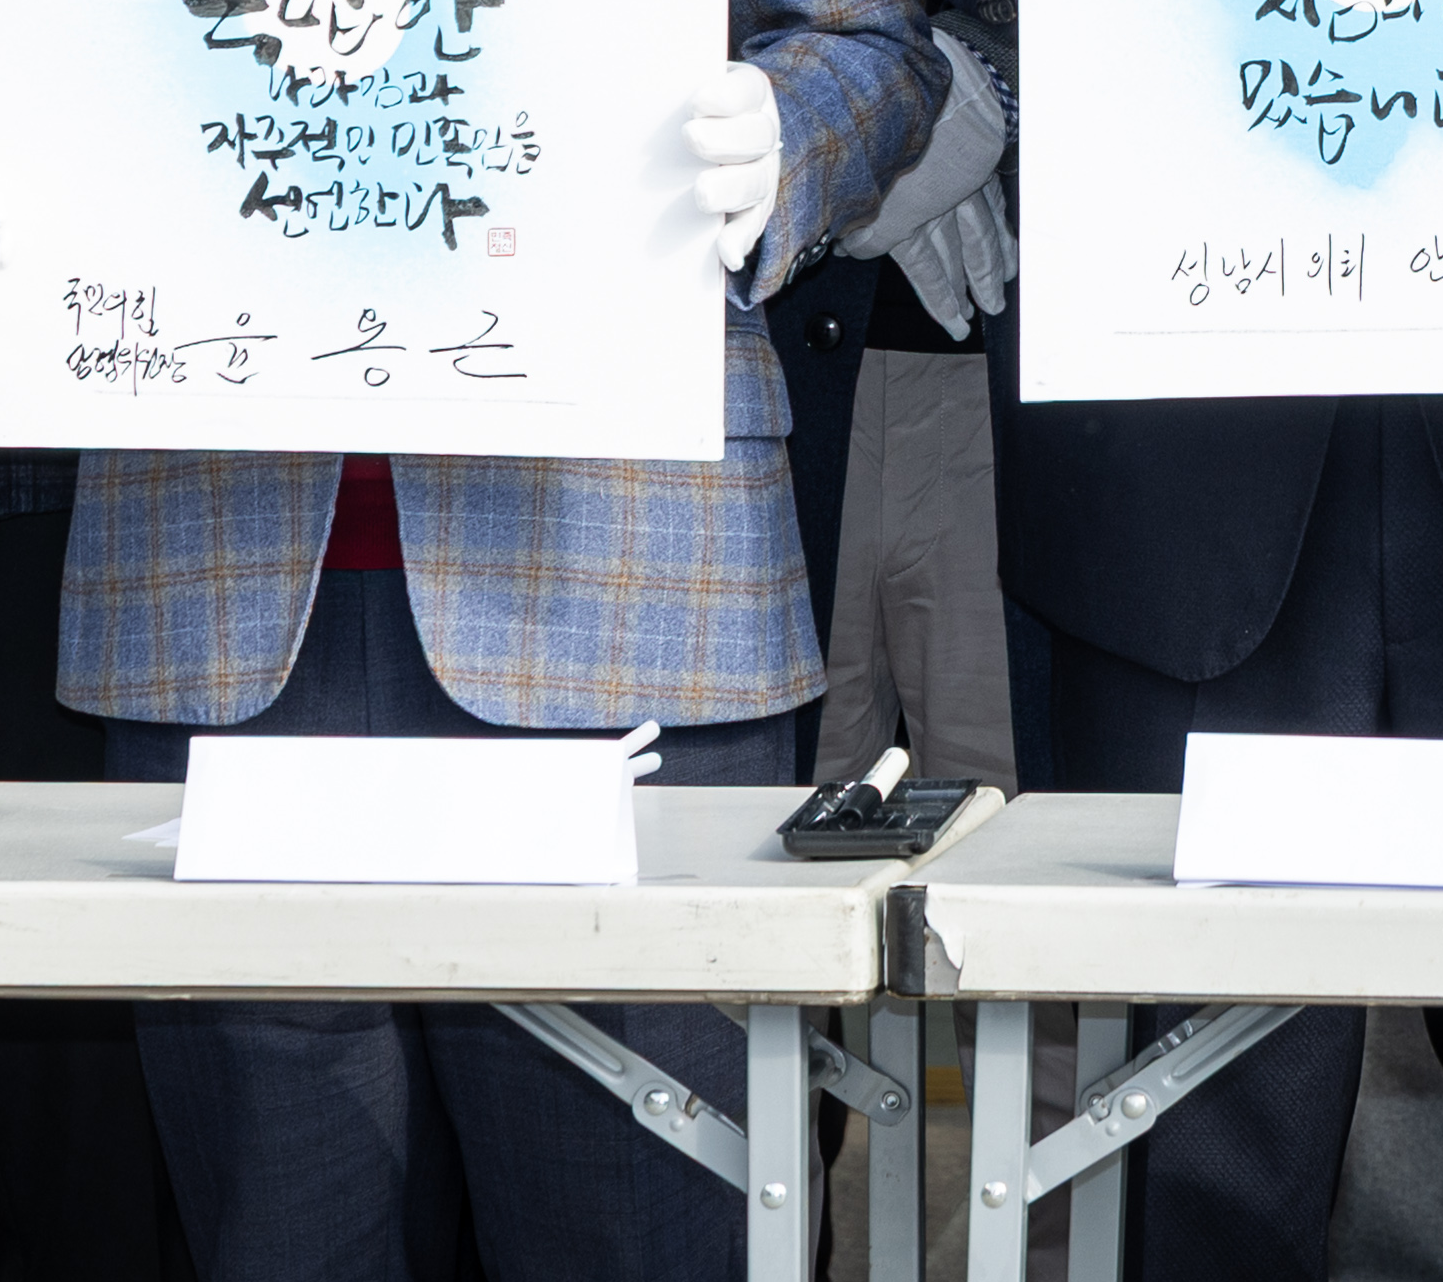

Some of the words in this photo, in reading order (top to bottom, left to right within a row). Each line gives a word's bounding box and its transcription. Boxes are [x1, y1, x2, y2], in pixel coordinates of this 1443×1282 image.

[200, 113, 376, 173] 자주적인
[391, 110, 541, 180] 민족임을
[239, 167, 490, 250] 선언한다
[1171, 237, 1285, 307] 성남시
